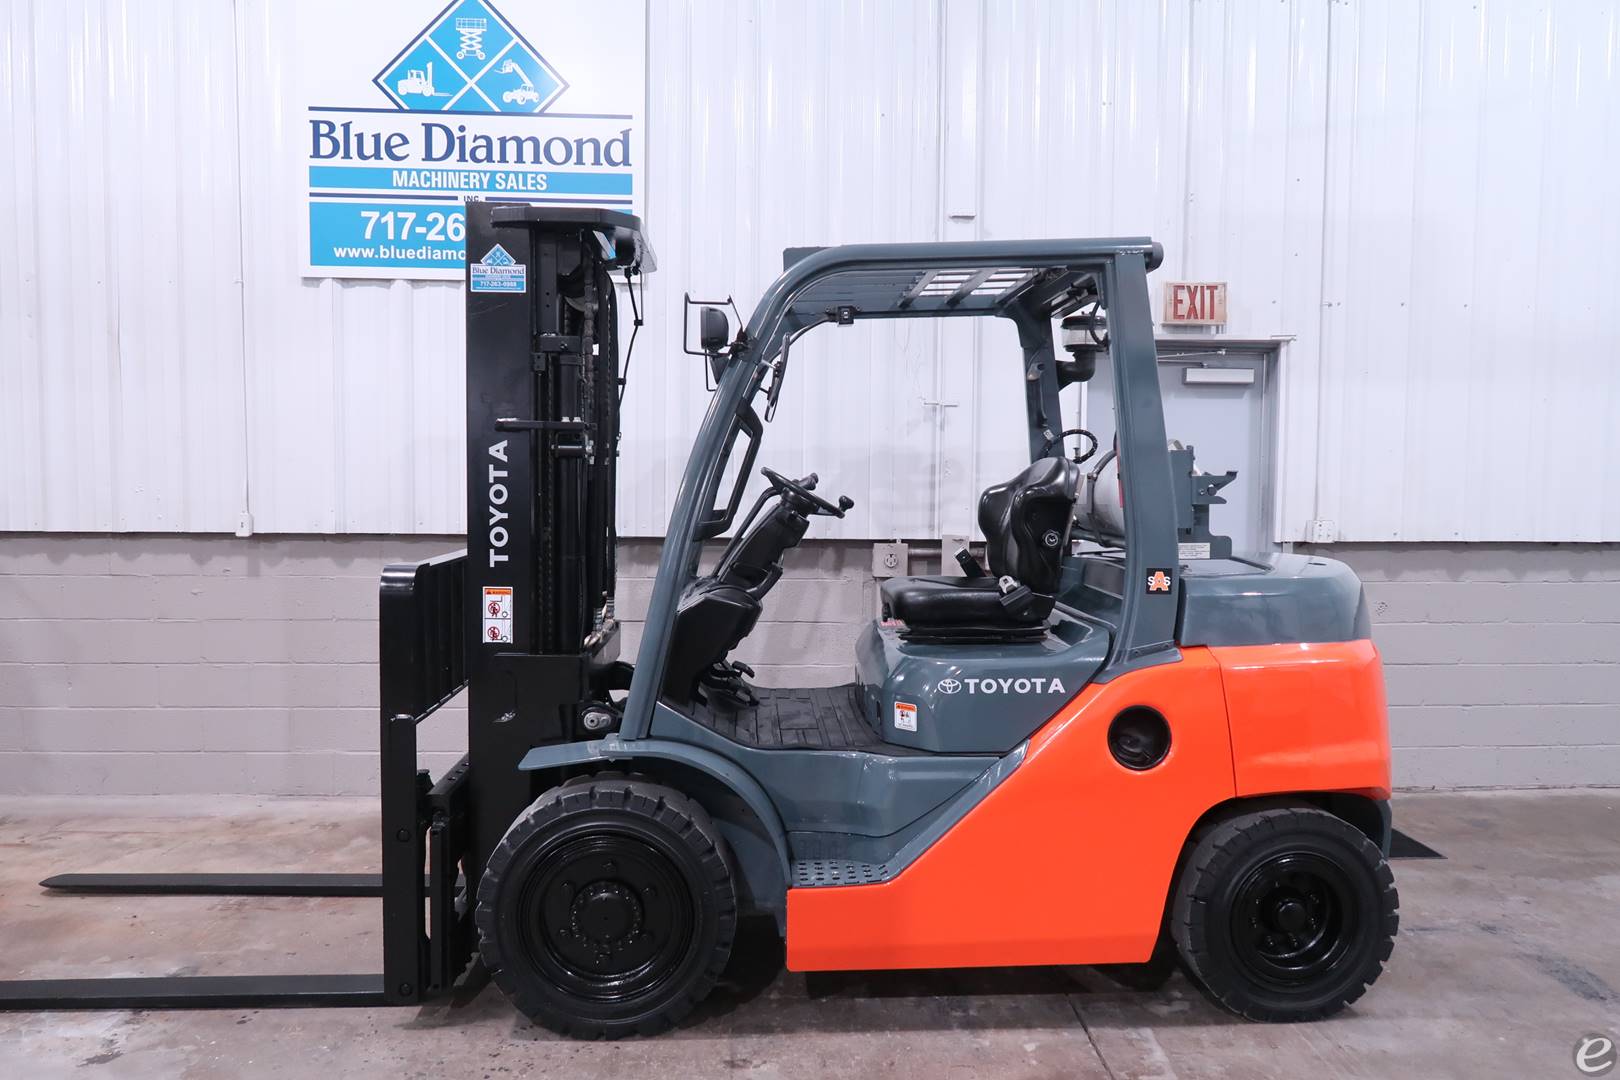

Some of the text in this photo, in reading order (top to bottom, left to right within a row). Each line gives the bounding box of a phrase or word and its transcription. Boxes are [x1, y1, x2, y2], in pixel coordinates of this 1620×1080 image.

[309, 119, 632, 167] Blue Diamond
[392, 169, 548, 191] MACHINERY SALES
[1173, 285, 1218, 320] EXIT
[488, 439, 509, 568] TOYOTA
[964, 678, 1066, 694] TOYOTA
